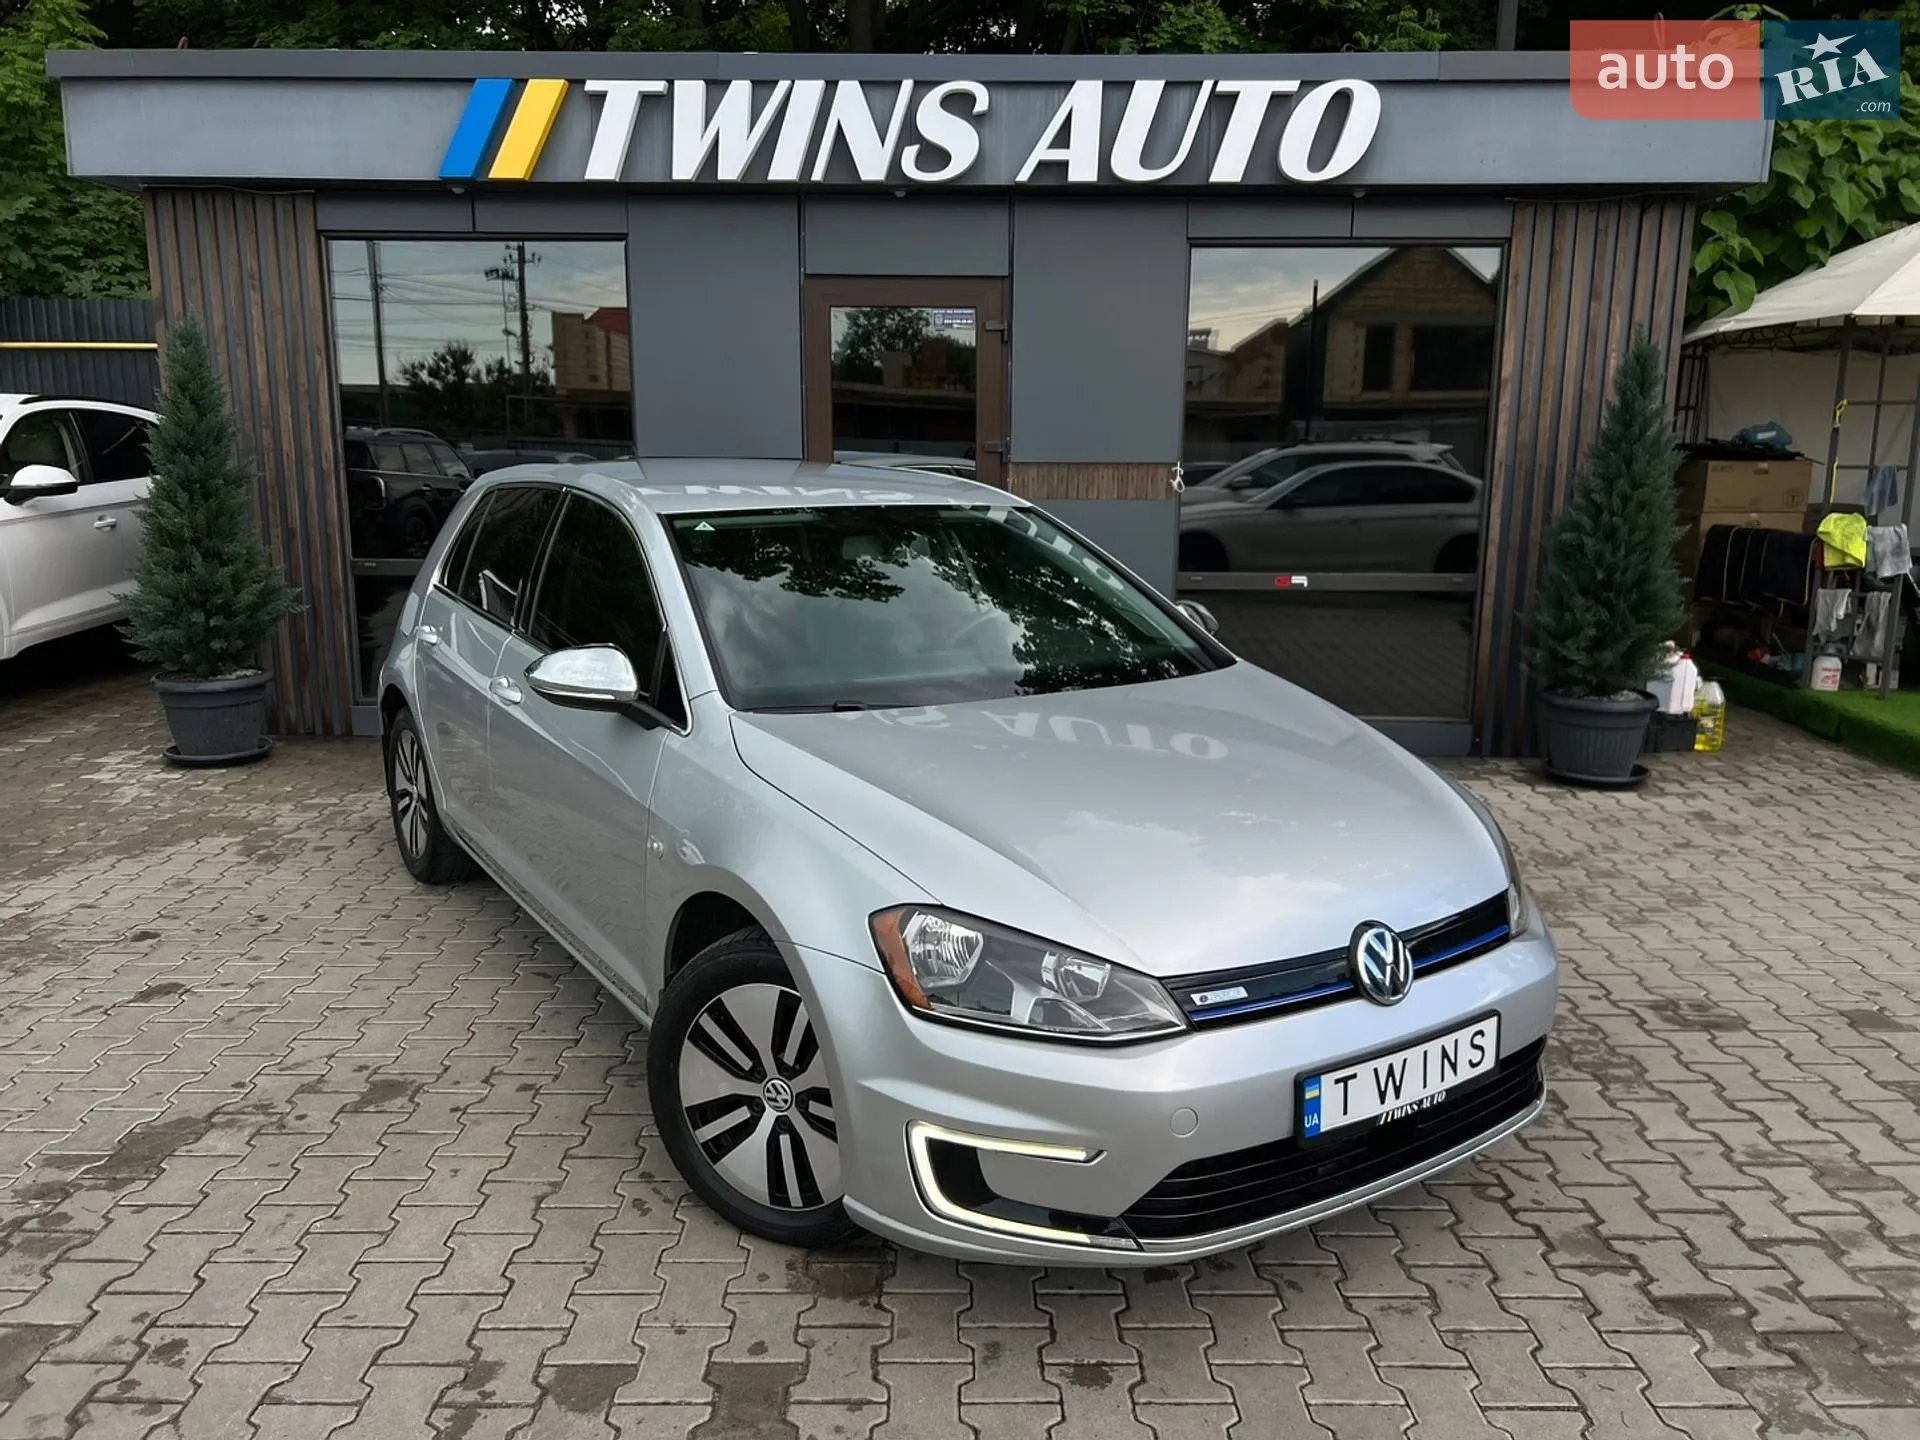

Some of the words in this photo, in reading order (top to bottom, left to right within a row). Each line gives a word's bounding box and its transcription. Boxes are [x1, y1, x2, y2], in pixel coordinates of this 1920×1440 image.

[584, 79, 990, 183] TWINS
[1014, 79, 1382, 183] AUTO
[1334, 1029, 1486, 1116] TWINS
[1305, 1112, 1319, 1128] UA
